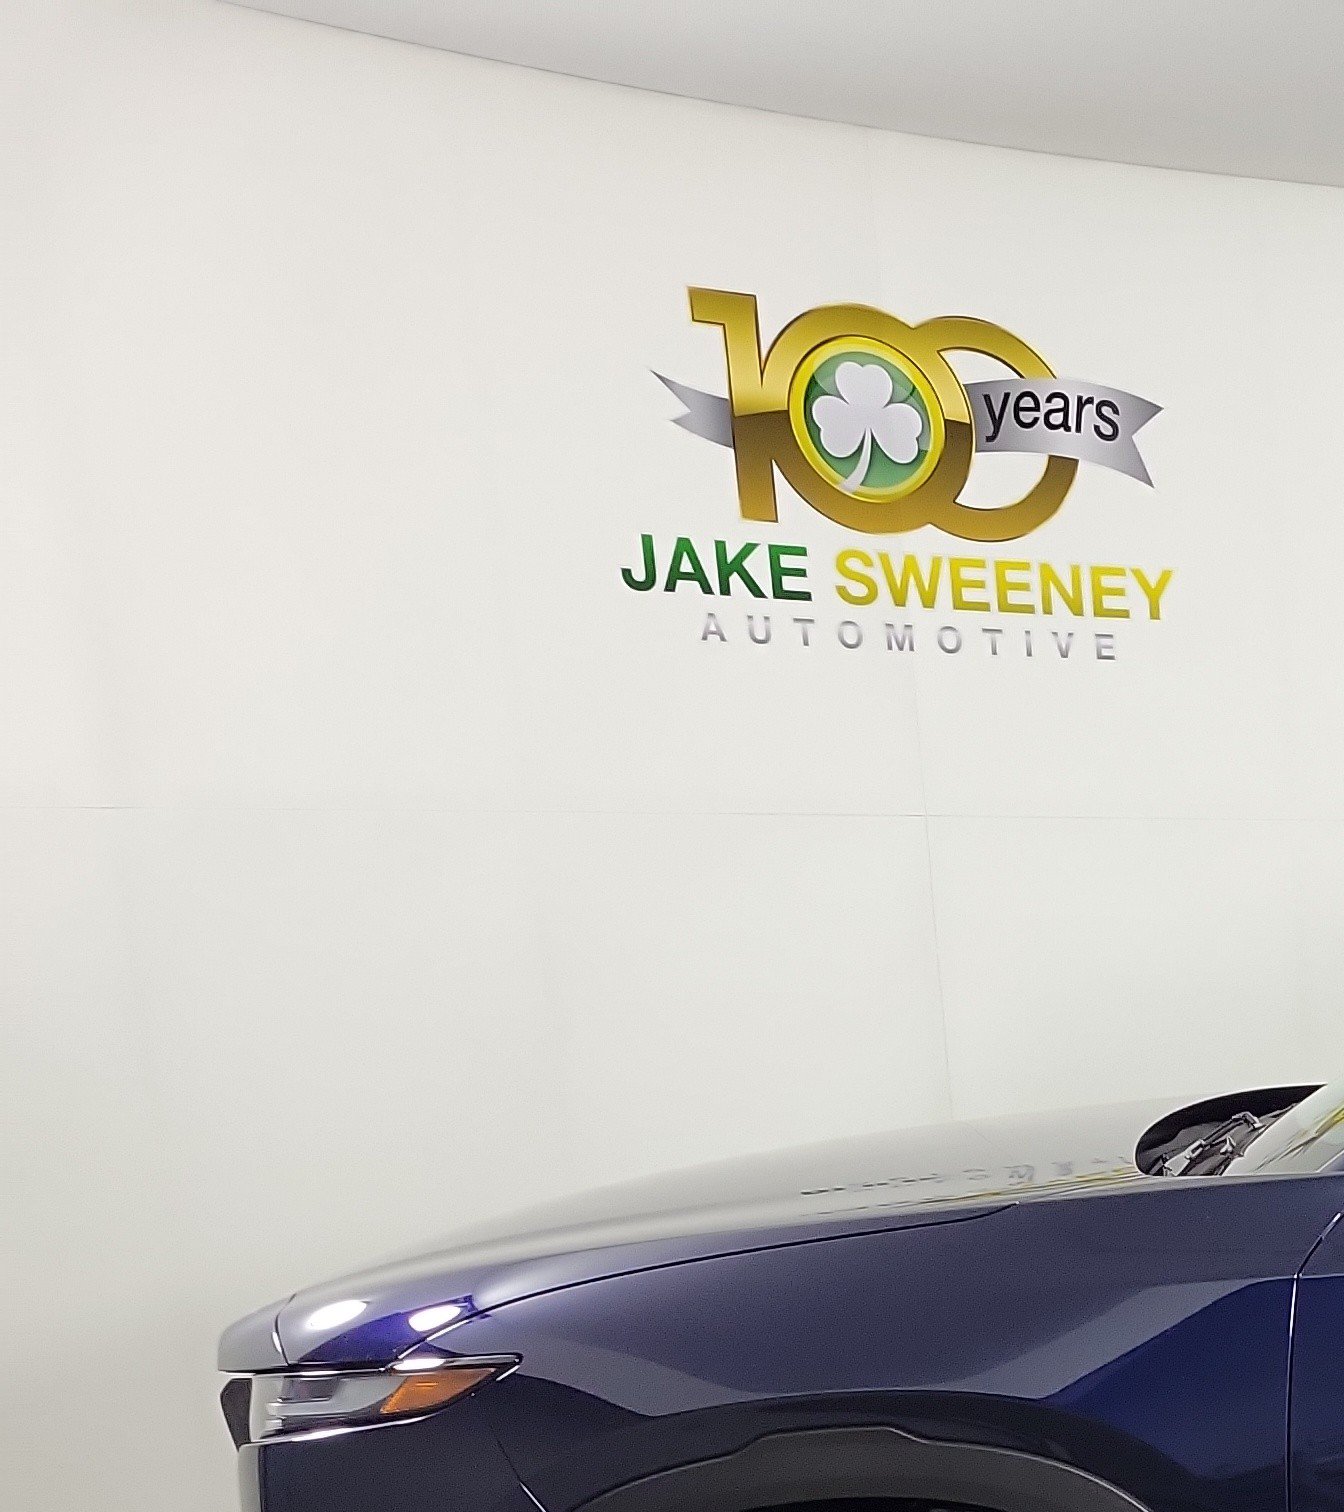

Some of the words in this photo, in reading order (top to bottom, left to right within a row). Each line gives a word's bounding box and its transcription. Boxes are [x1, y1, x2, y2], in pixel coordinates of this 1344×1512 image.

[686, 286, 1079, 543] 100
[983, 390, 1121, 443] years
[620, 534, 813, 602] JAKE
[834, 549, 1174, 621] SWEENEY
[700, 613, 1118, 661] AUTOMOTIVE
